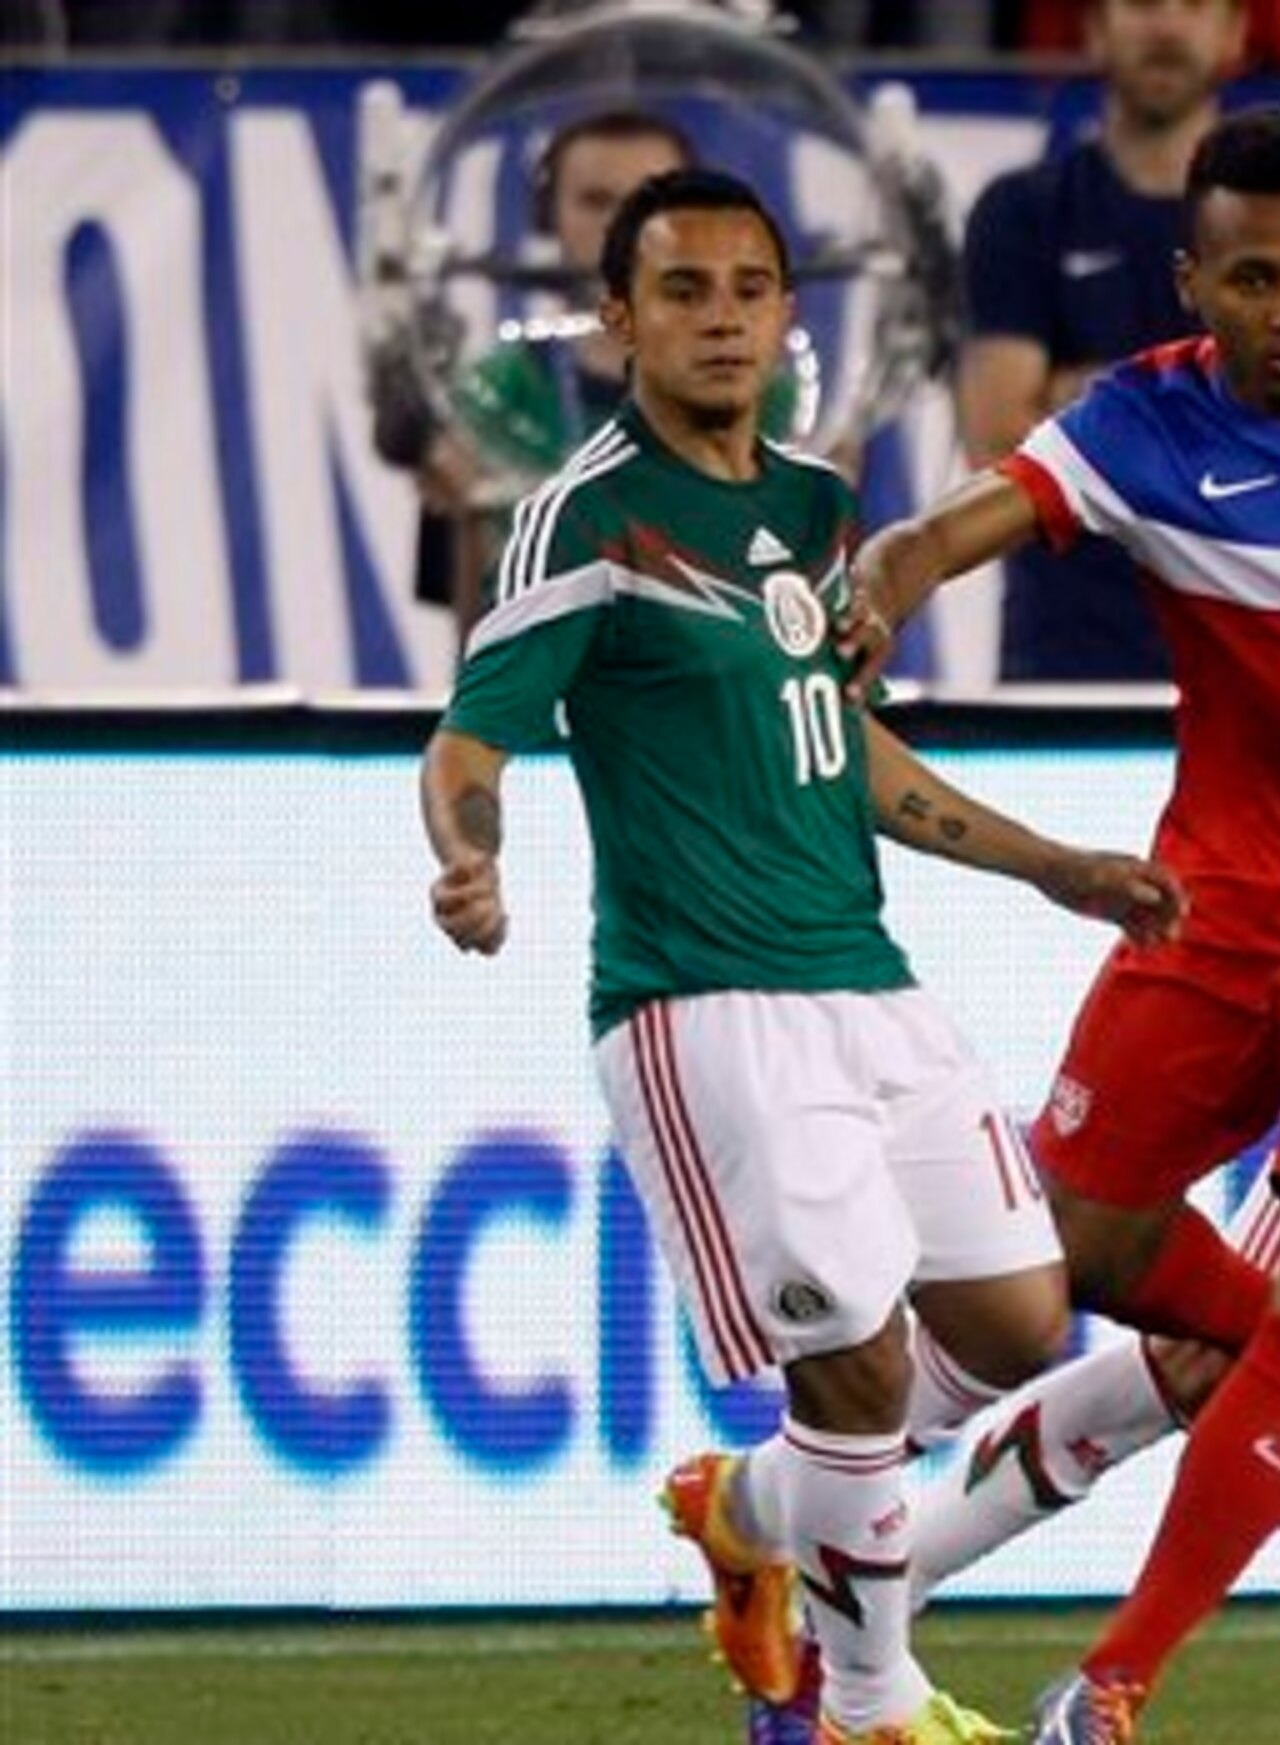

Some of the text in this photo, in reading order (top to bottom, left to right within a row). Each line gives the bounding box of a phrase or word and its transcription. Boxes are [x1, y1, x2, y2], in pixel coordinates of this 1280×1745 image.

[0, 108, 590, 690] ON
[780, 673, 846, 785] 10
[10, 1124, 1090, 1480] ecci
